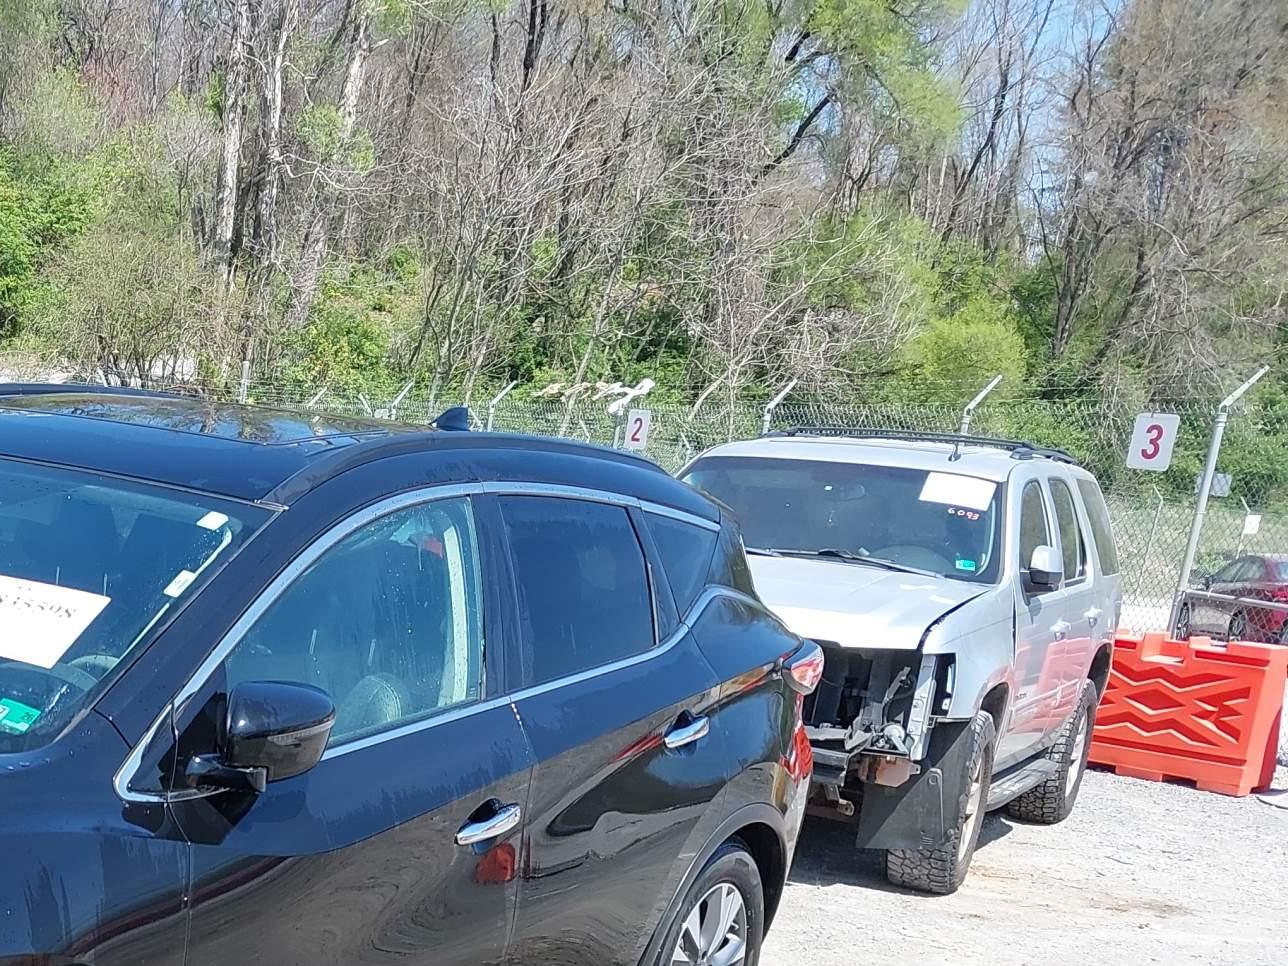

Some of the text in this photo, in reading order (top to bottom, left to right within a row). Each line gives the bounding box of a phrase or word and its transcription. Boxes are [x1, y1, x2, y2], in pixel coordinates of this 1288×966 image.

[630, 417, 643, 442] 2
[1141, 424, 1164, 460] 3
[947, 507, 980, 521] 6093
